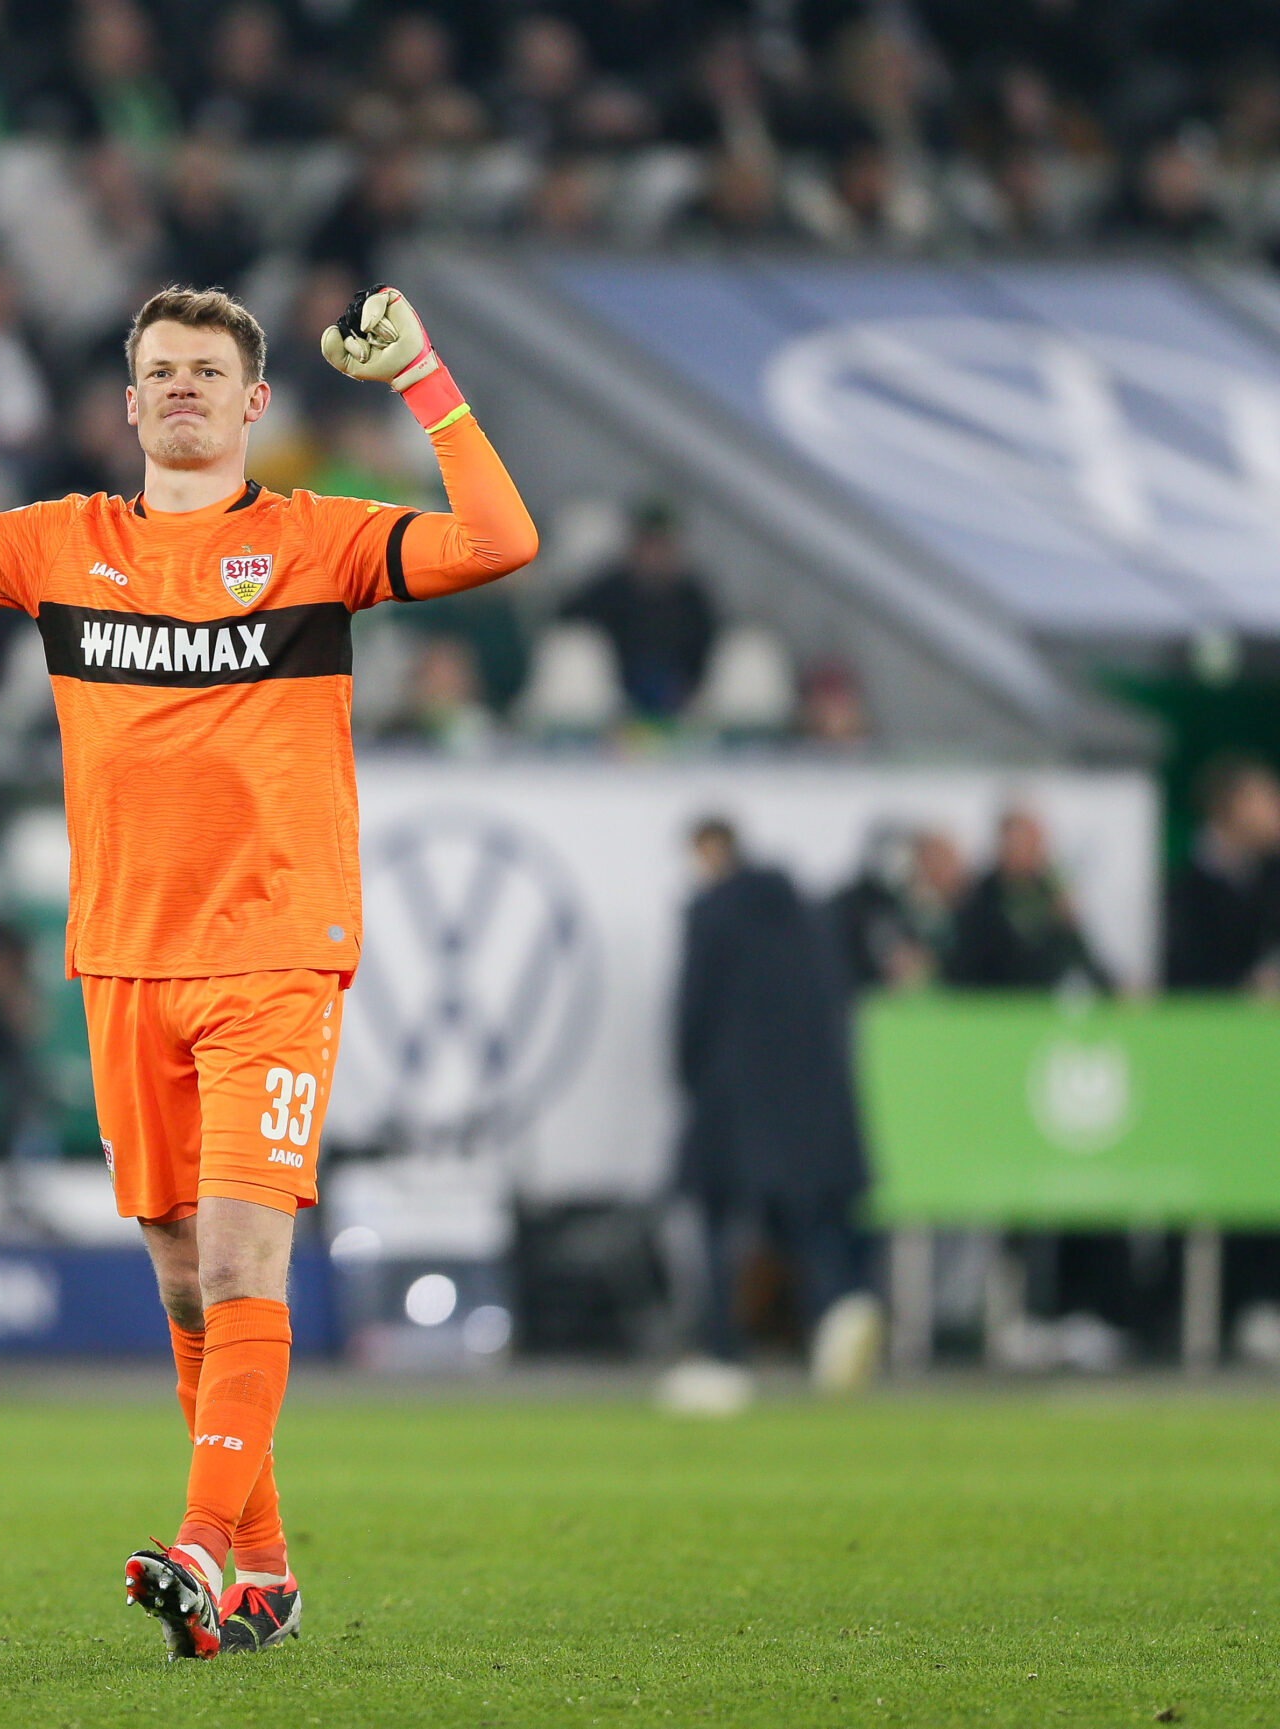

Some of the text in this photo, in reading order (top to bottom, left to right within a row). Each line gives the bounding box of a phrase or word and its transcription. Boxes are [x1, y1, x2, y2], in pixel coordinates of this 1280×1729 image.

[88, 561, 129, 586] JAKO
[80, 620, 270, 673] WINAMAX
[260, 1067, 317, 1147] 33
[267, 1147, 304, 1169] JAKO
[195, 1433, 244, 1451] VfB
